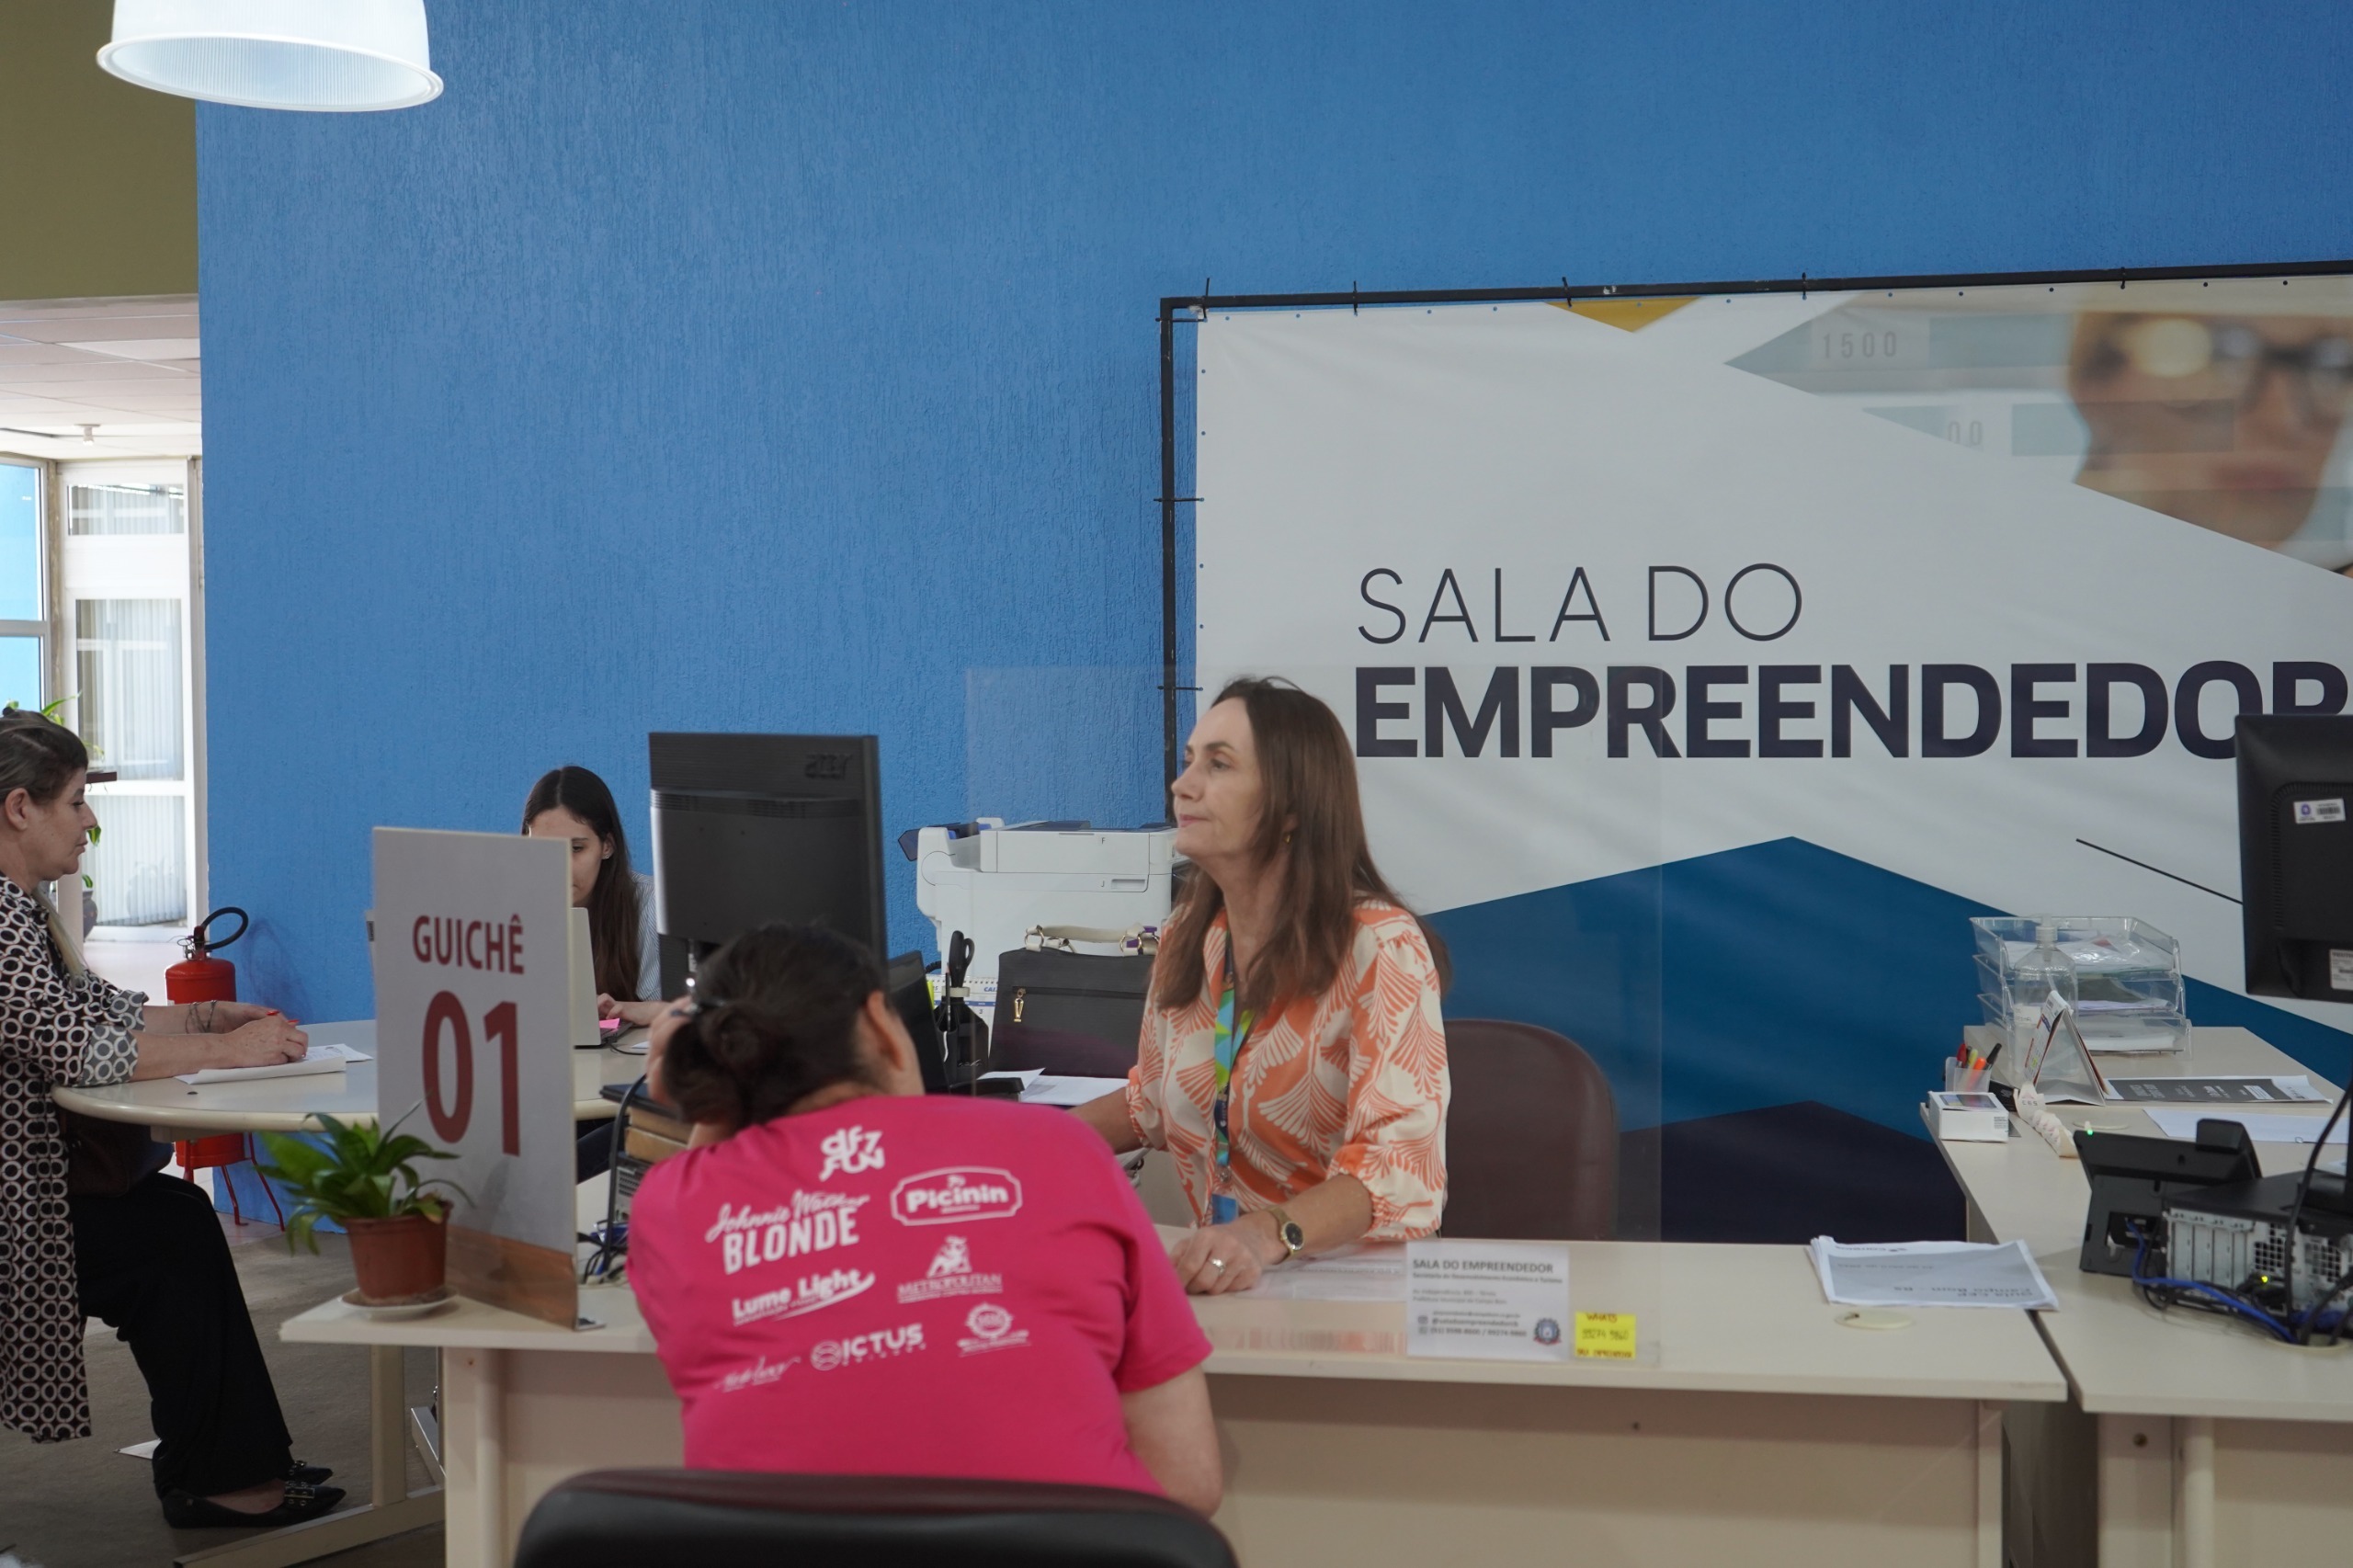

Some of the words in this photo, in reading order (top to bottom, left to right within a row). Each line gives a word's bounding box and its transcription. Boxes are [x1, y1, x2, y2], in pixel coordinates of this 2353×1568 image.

[1823, 331, 1898, 359] 1500
[1358, 567, 1611, 644] SALA
[1648, 562, 1802, 642] DO
[412, 913, 525, 975] GUICHÊ
[421, 990, 521, 1157] 01
[905, 1183, 1009, 1214] Picinin
[705, 1202, 790, 1243] Johnnie
[722, 1207, 860, 1276] BLONDE
[1413, 1258, 1440, 1270] SALA
[1442, 1260, 1460, 1270] DO
[1461, 1260, 1554, 1274] EMPREENDEDOR
[732, 1288, 791, 1320] Lume
[797, 1268, 861, 1302] Light
[843, 1323, 924, 1358] ICTUS
